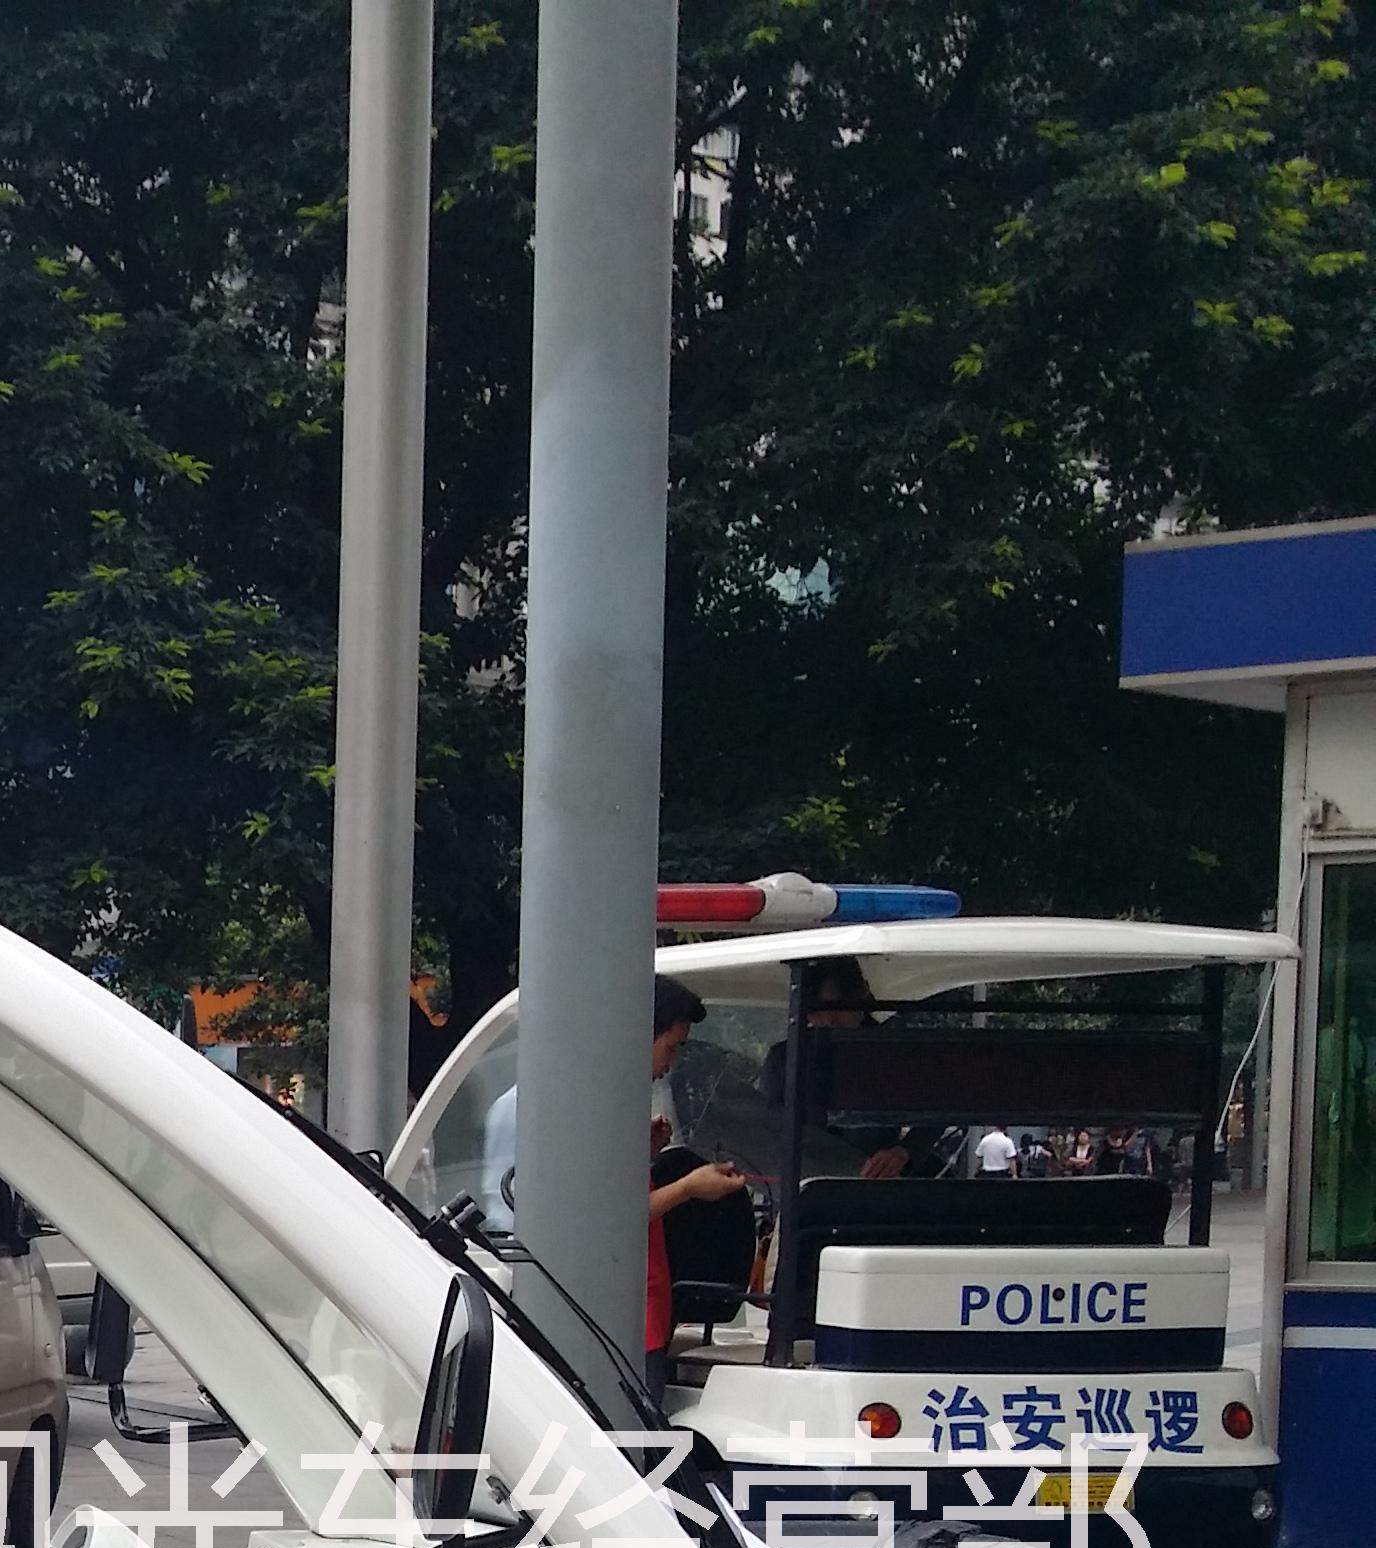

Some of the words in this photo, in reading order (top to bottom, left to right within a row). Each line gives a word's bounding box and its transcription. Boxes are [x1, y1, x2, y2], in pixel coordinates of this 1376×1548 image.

[960, 1282, 1148, 1326] POLICE
[922, 1386, 1203, 1454] 治安巡逻
